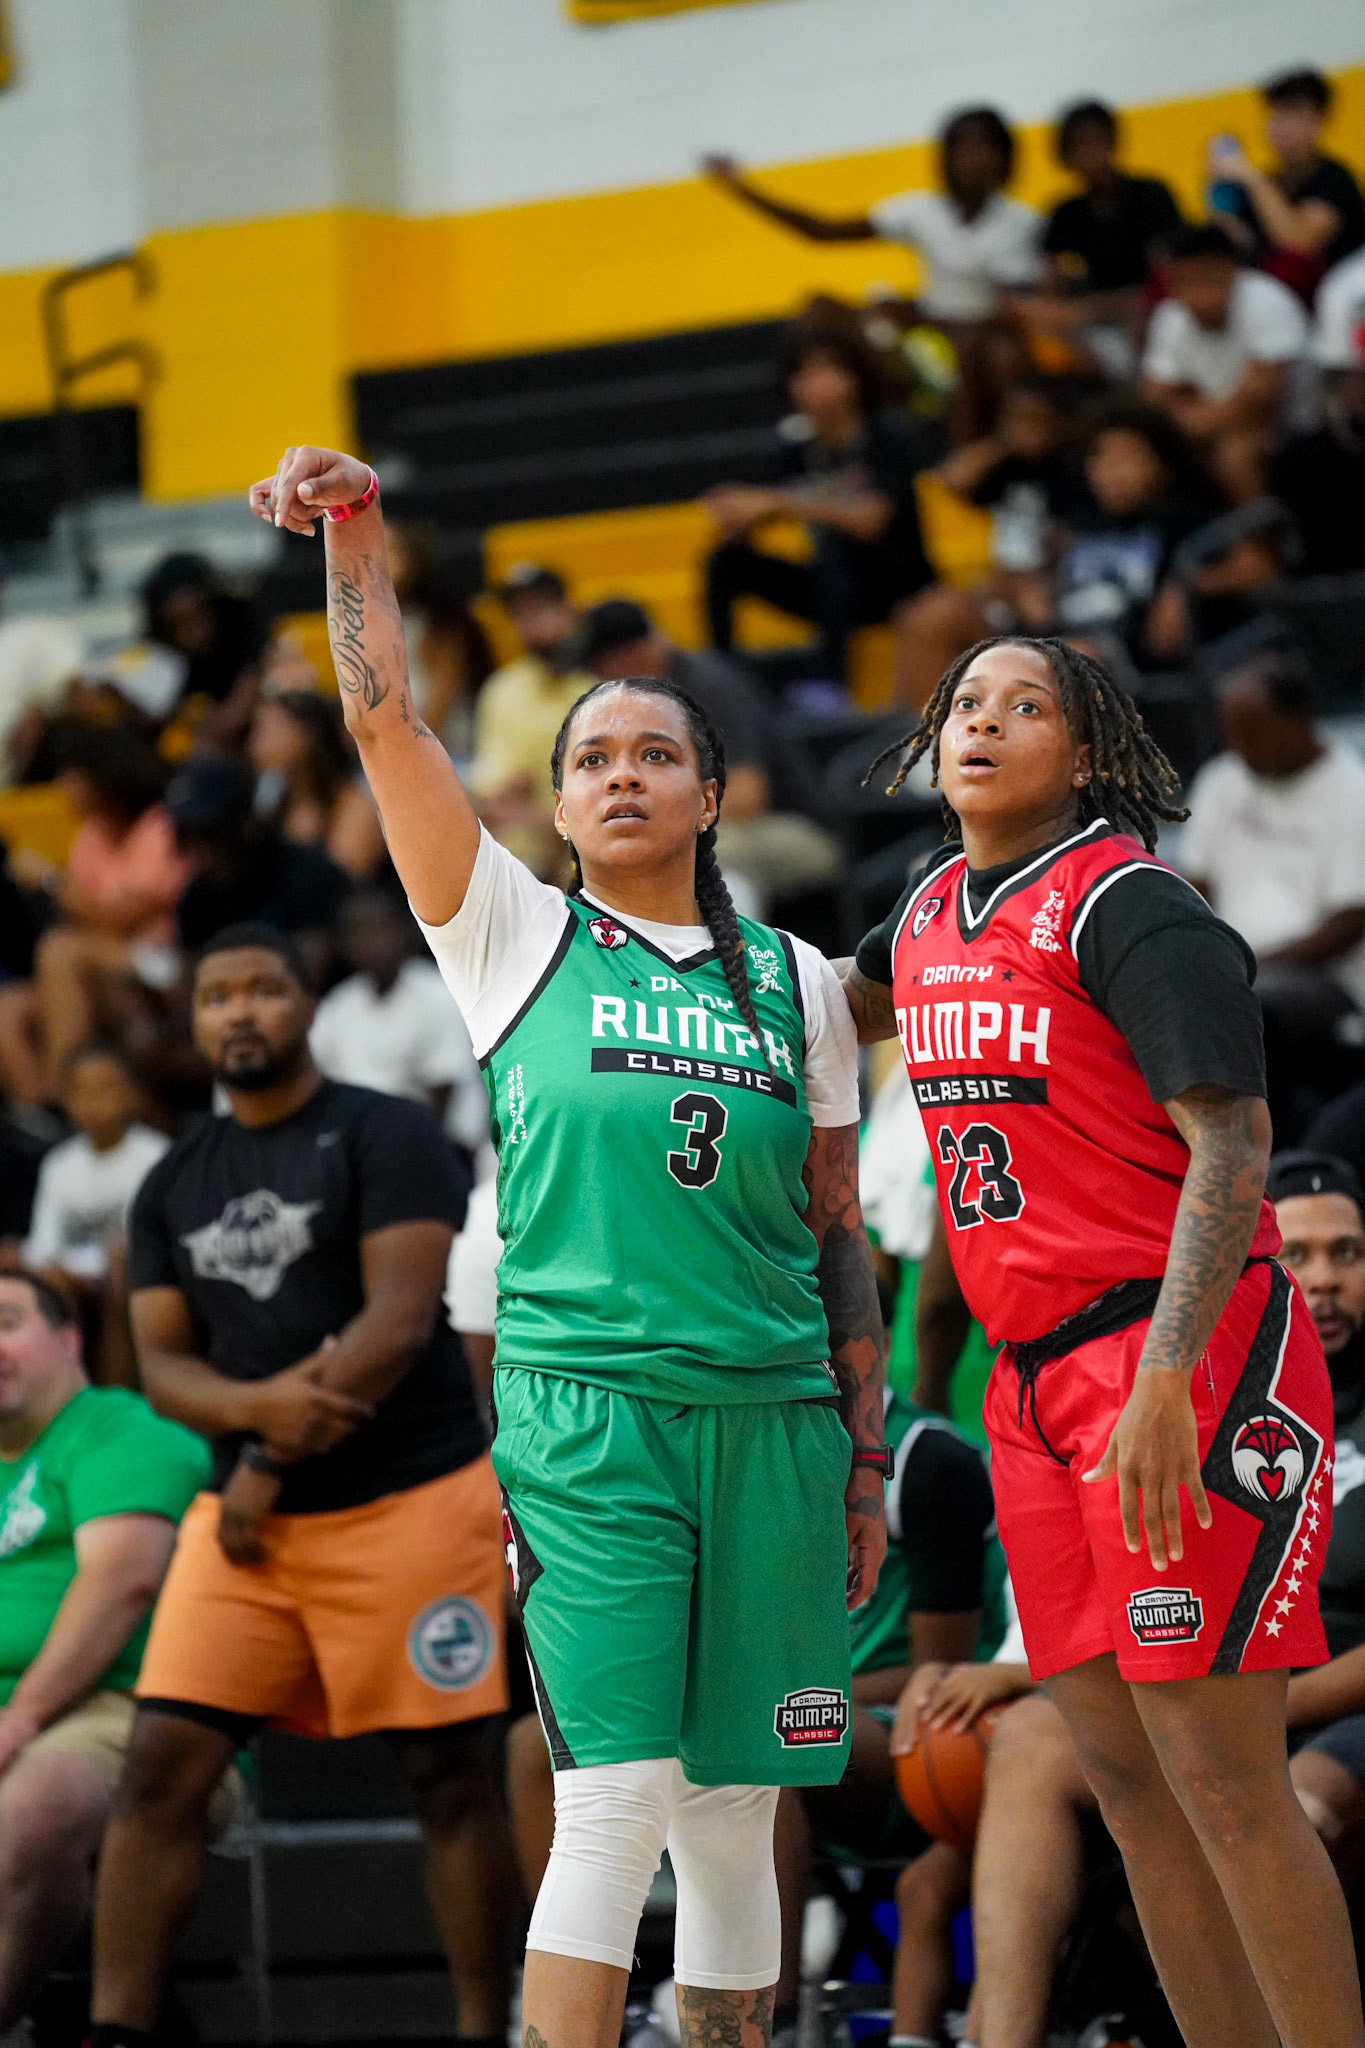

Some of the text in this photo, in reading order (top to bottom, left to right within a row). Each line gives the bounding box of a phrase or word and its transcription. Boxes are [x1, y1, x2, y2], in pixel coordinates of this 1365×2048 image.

[922, 965, 994, 986] DANNY
[650, 975, 734, 1012] DANY
[590, 994, 795, 1077] RUMPH
[895, 1001, 1051, 1065] RUMPH
[627, 1053, 772, 1092] CLASSIC
[917, 1079, 1012, 1103] CLASSIC
[667, 1091, 728, 1190] 3
[937, 1122, 1026, 1231] 23
[1144, 1595, 1174, 1604] DANNY
[1132, 1604, 1197, 1626] RUMPH
[1144, 1628, 1186, 1638] CLASSIC
[798, 1696, 828, 1704] DANNY
[781, 1706, 844, 1728] RUMPH
[793, 1730, 833, 1740] CLASSIC
